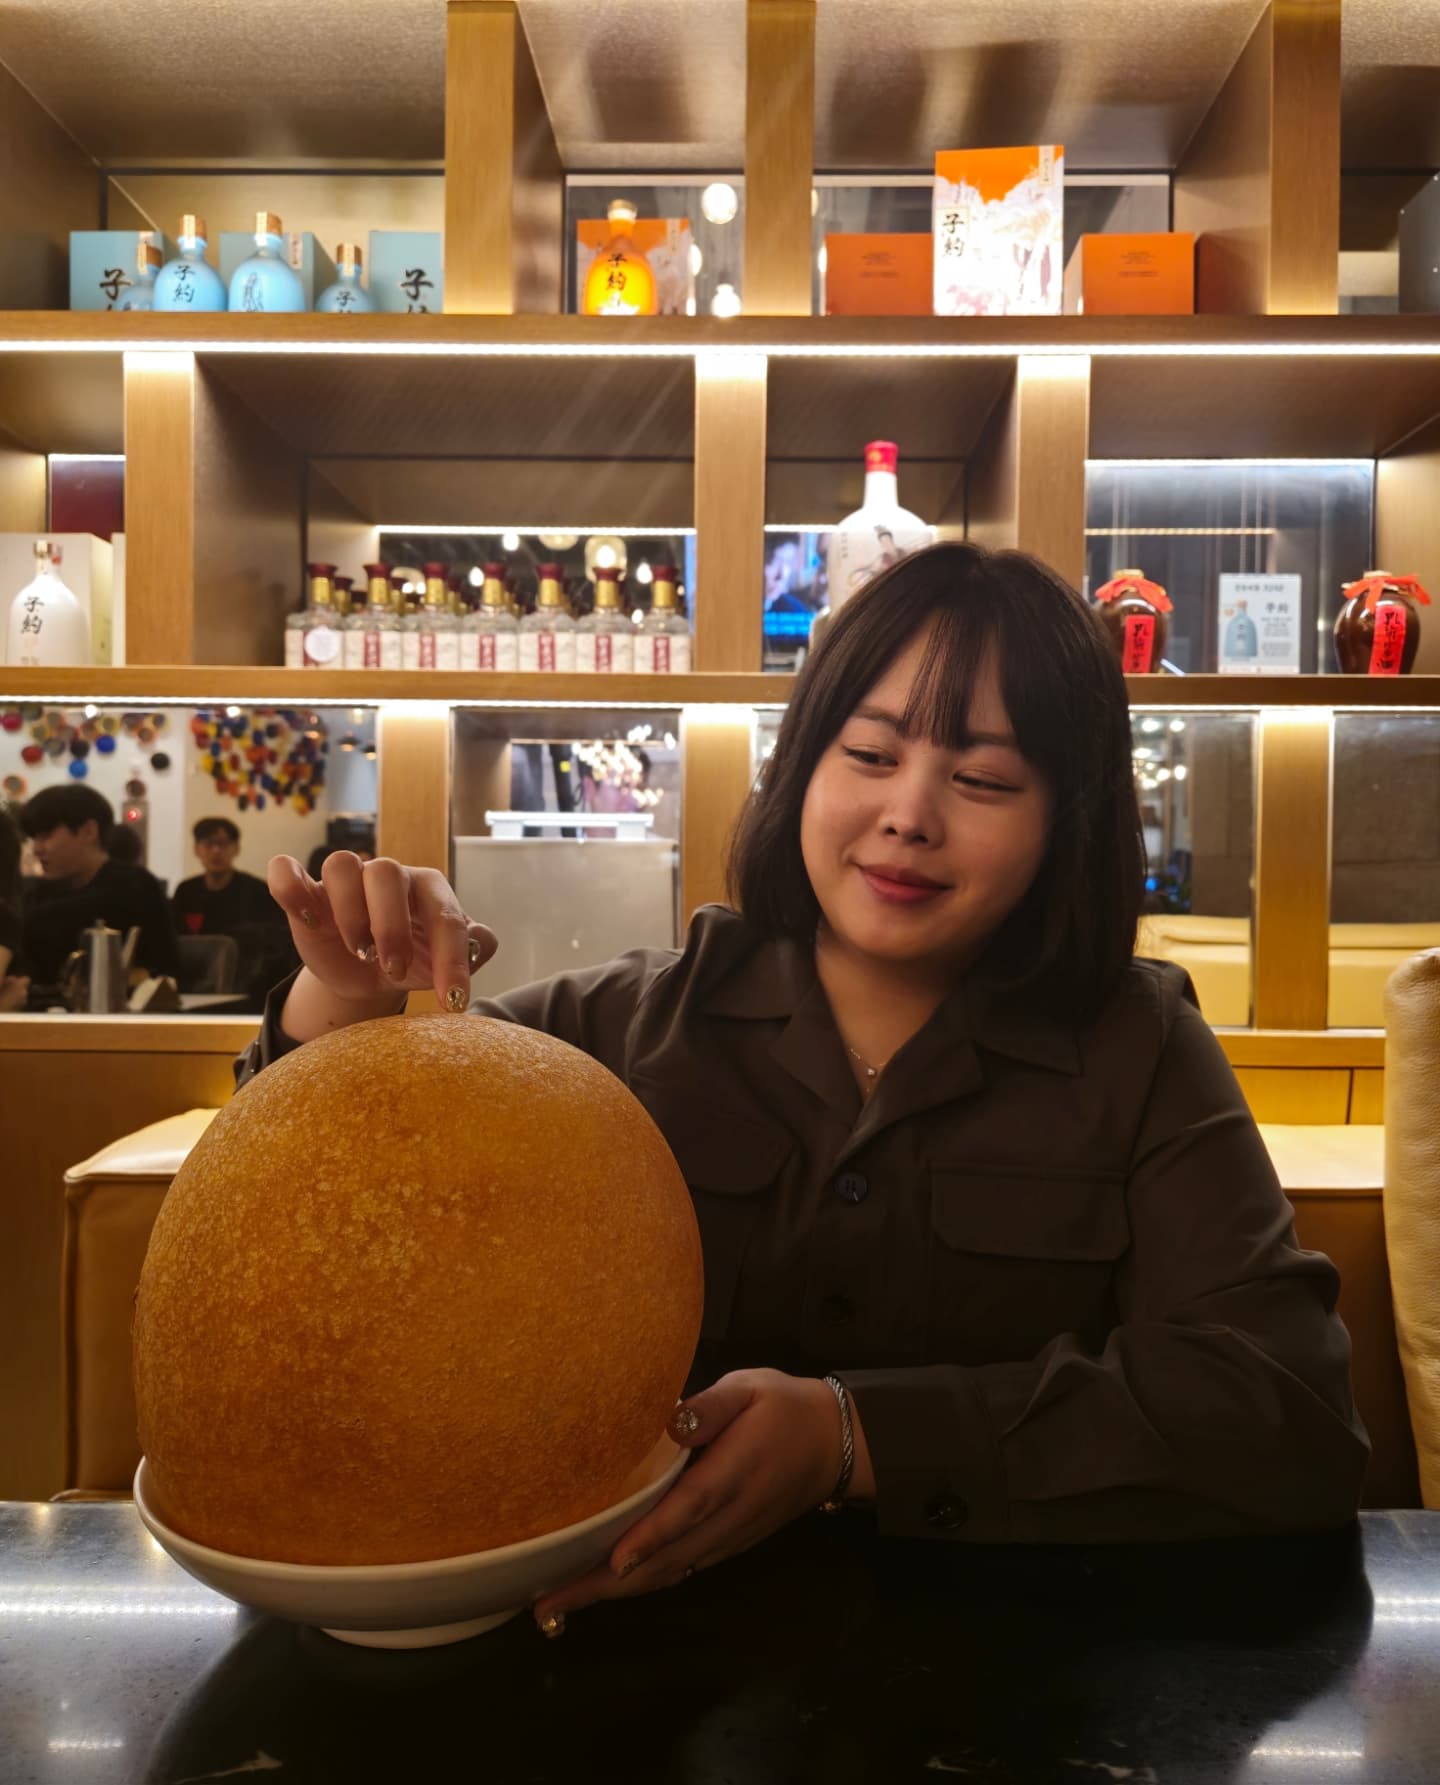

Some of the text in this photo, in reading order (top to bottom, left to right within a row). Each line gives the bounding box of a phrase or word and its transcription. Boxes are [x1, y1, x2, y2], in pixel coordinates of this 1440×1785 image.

[942, 213, 965, 258] 子約
[99, 268, 132, 310] 子
[174, 264, 196, 303] 子約
[336, 290, 356, 313] 子
[21, 595, 45, 635] 子約
